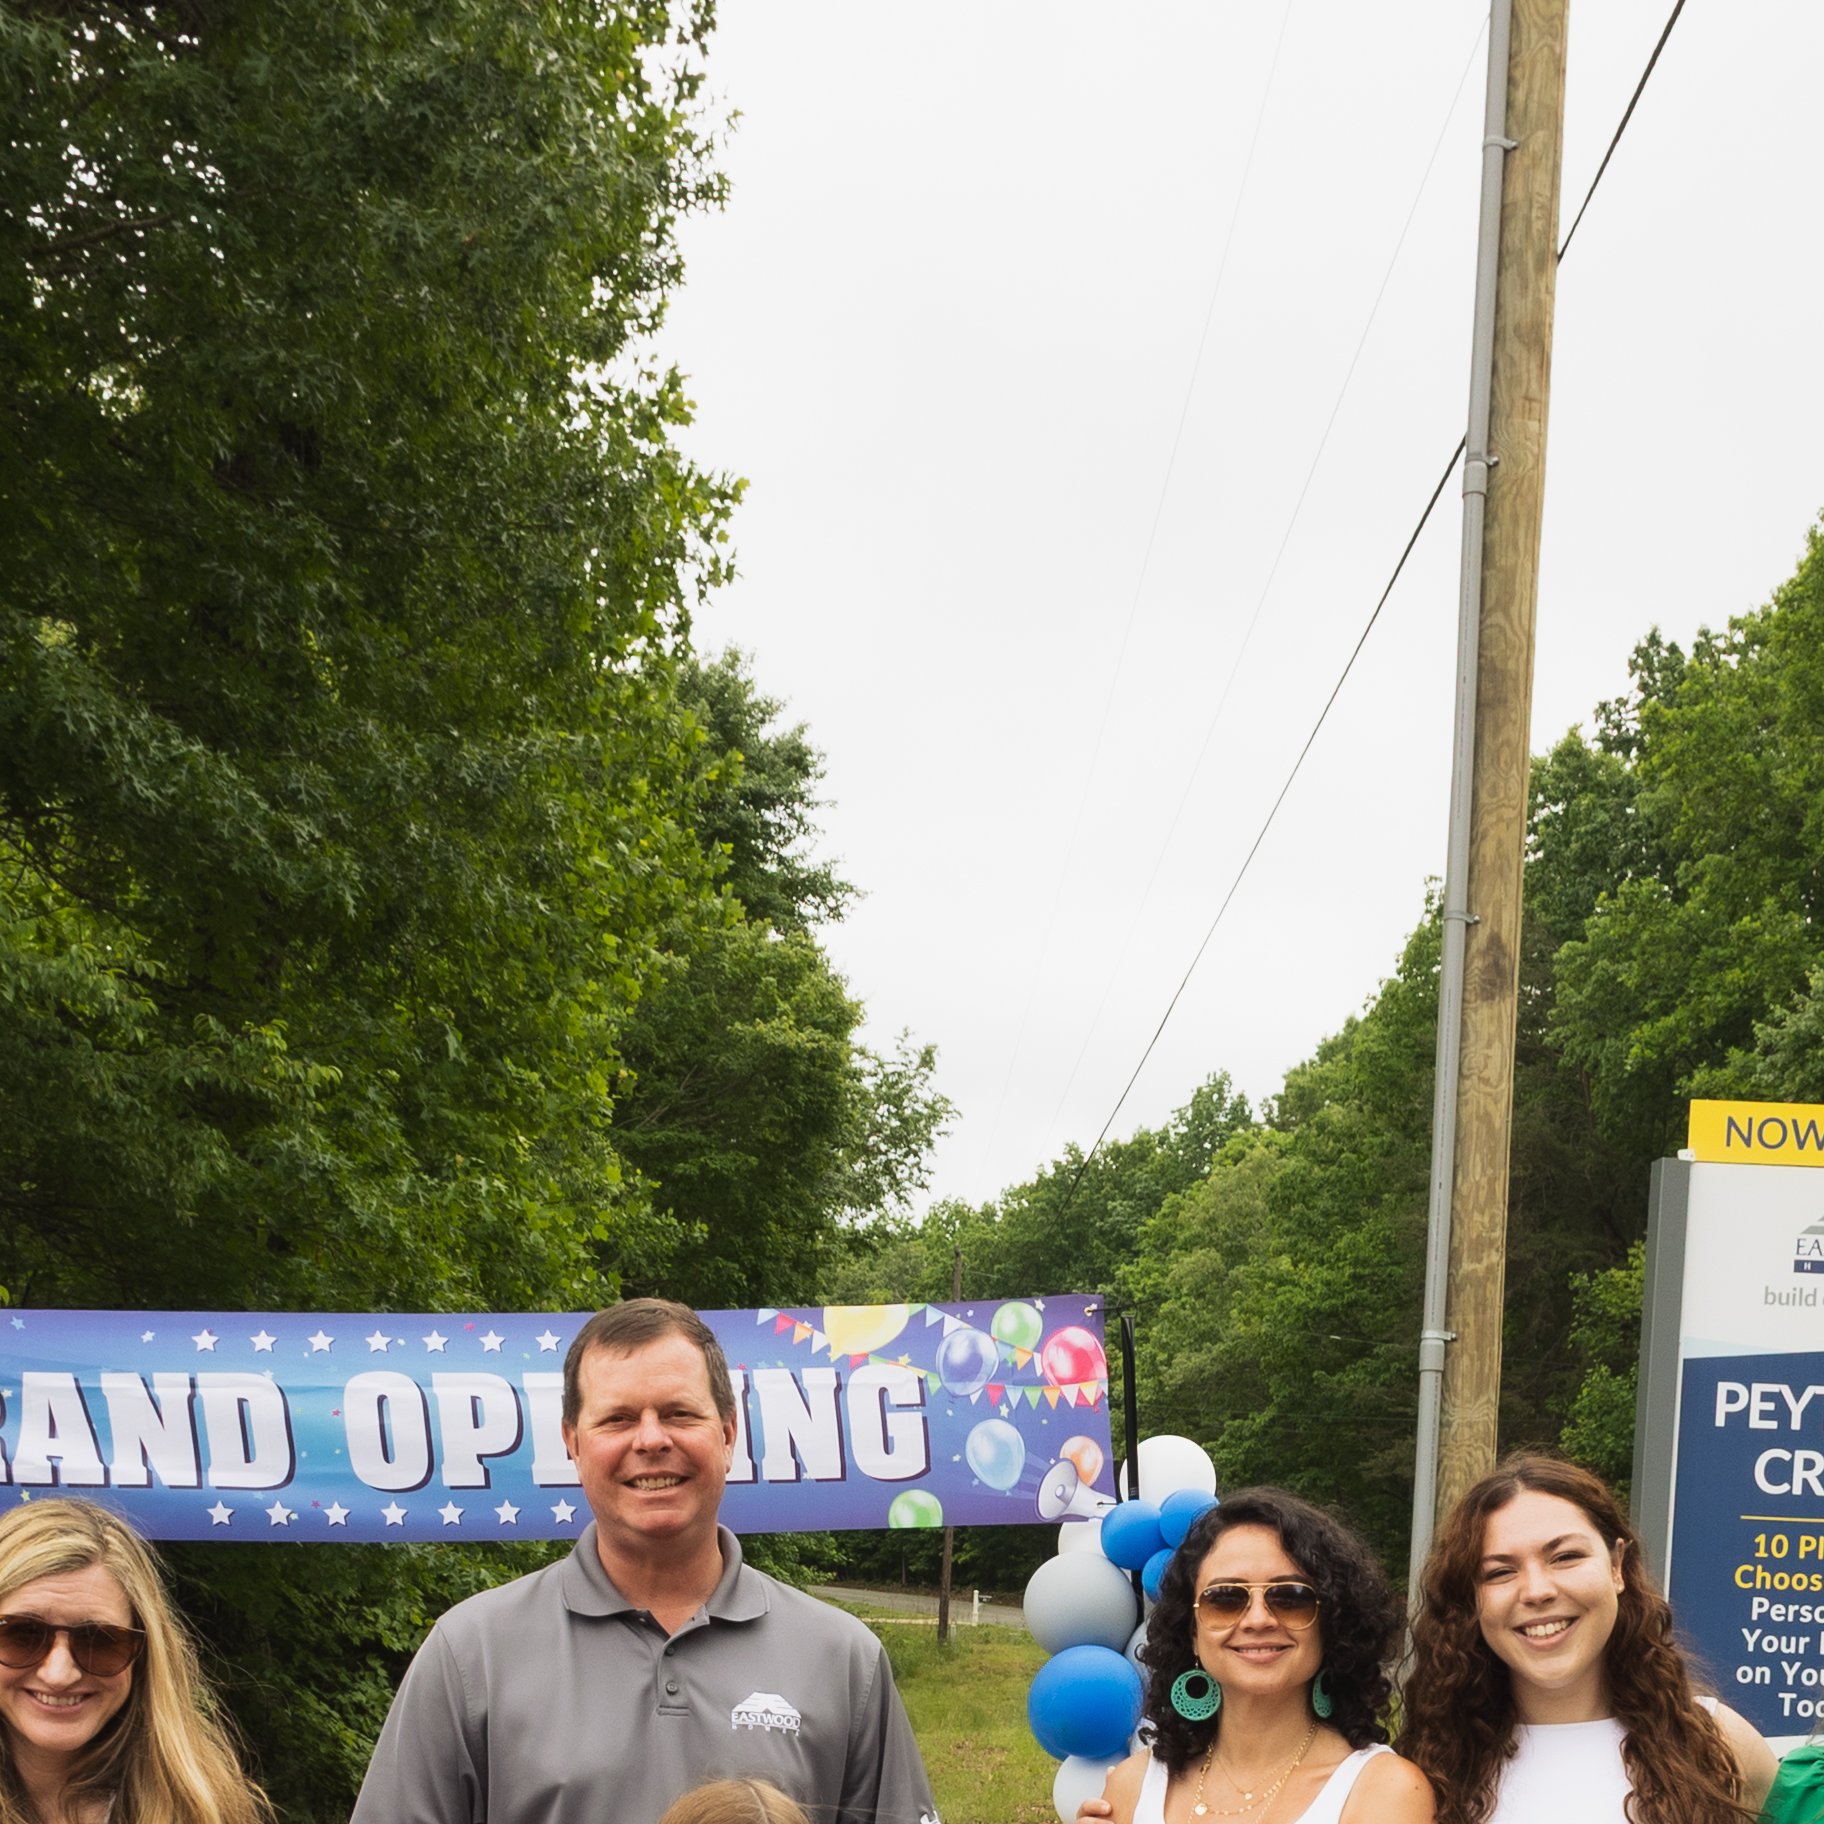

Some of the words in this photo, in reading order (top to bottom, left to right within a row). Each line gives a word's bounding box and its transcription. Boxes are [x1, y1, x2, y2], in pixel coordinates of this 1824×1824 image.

[1764, 1285, 1817, 1307] build
[1753, 1533, 1789, 1558] 10
[1741, 1628, 1810, 1654] Your
[1736, 1664, 1771, 1684] on
[731, 1711, 801, 1729] EASTWOOD
